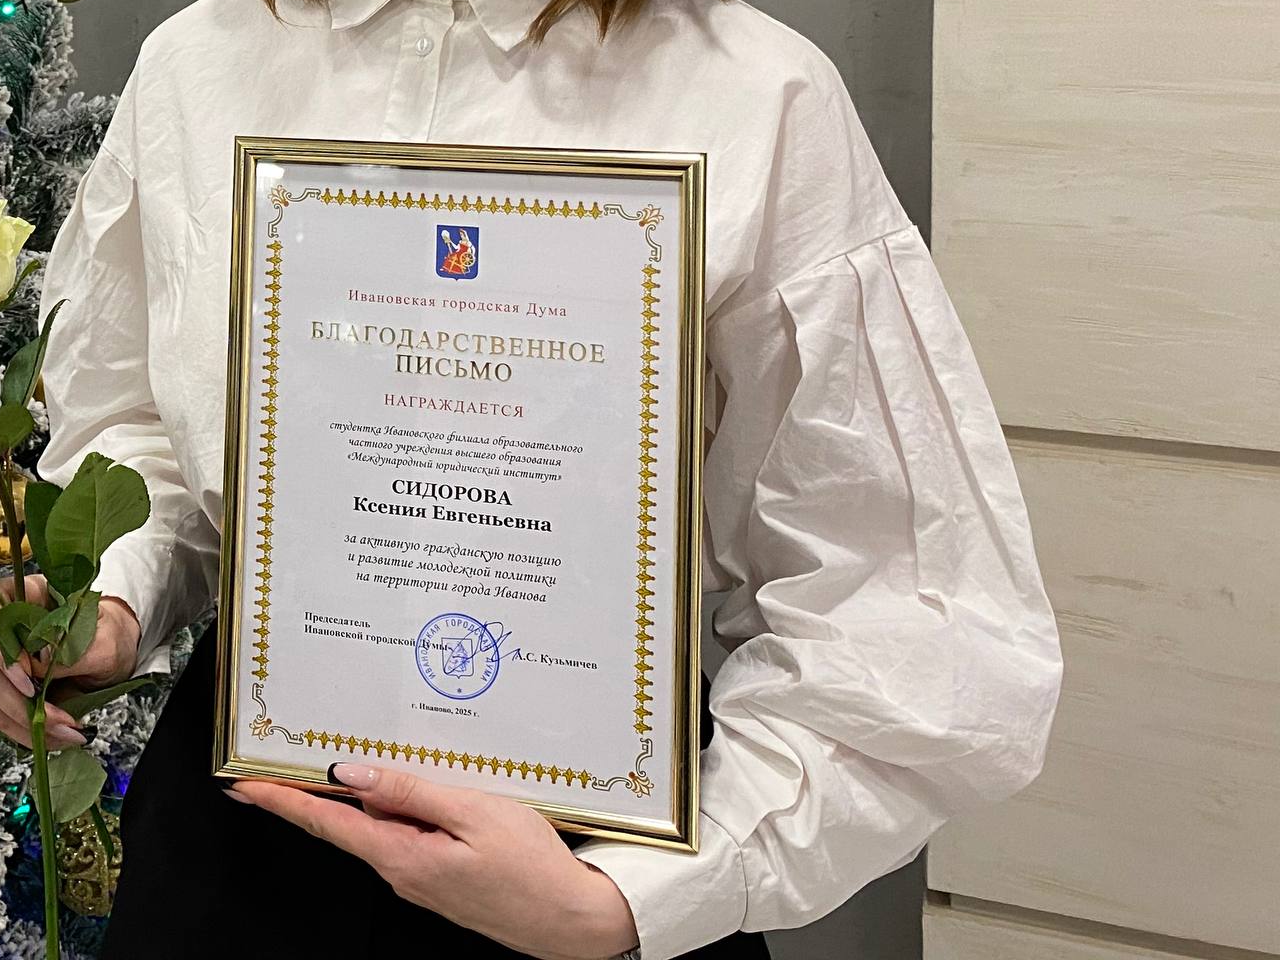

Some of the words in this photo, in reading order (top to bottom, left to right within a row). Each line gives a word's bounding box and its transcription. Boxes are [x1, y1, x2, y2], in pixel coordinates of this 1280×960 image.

[348, 290, 436, 308] Ивановская
[442, 298, 520, 314] городская
[526, 302, 568, 318] Дума
[311, 321, 606, 364] БЛАГОДАРСТВЕННОЕ
[395, 354, 512, 382] ПИСЬМО
[384, 394, 524, 418] НАГРАЖДАЕТСЯ
[329, 420, 382, 435] студентка
[383, 426, 445, 441] Ивановского
[447, 430, 490, 446] филиала
[492, 436, 584, 454] образовательного
[348, 439, 392, 451] частного
[394, 442, 453, 457] учреждения
[455, 449, 496, 462] высшего
[498, 450, 562, 466] образования
[347, 452, 434, 468] «Международный
[435, 460, 501, 477] юридический
[502, 467, 562, 483] институт»
[392, 479, 513, 506] СИДОРОВА
[352, 496, 427, 519] Ксения
[432, 505, 552, 532] Евгеньевна
[344, 534, 357, 544] за
[360, 536, 421, 553] активную
[422, 542, 504, 562] гражданскую
[507, 552, 562, 568] позицию
[348, 552, 355, 562] и
[358, 553, 414, 569] развитие
[416, 560, 491, 578] молодежной
[494, 570, 557, 588] политики
[356, 571, 370, 582] на
[373, 574, 448, 592] территории
[451, 582, 491, 598] города
[493, 586, 547, 603] Иванова
[304, 612, 371, 628] Председатель
[304, 624, 364, 640] Ивановской
[366, 634, 416, 647] городской
[540, 654, 598, 670] Кузьмичев
[454, 706, 472, 717] 2025
